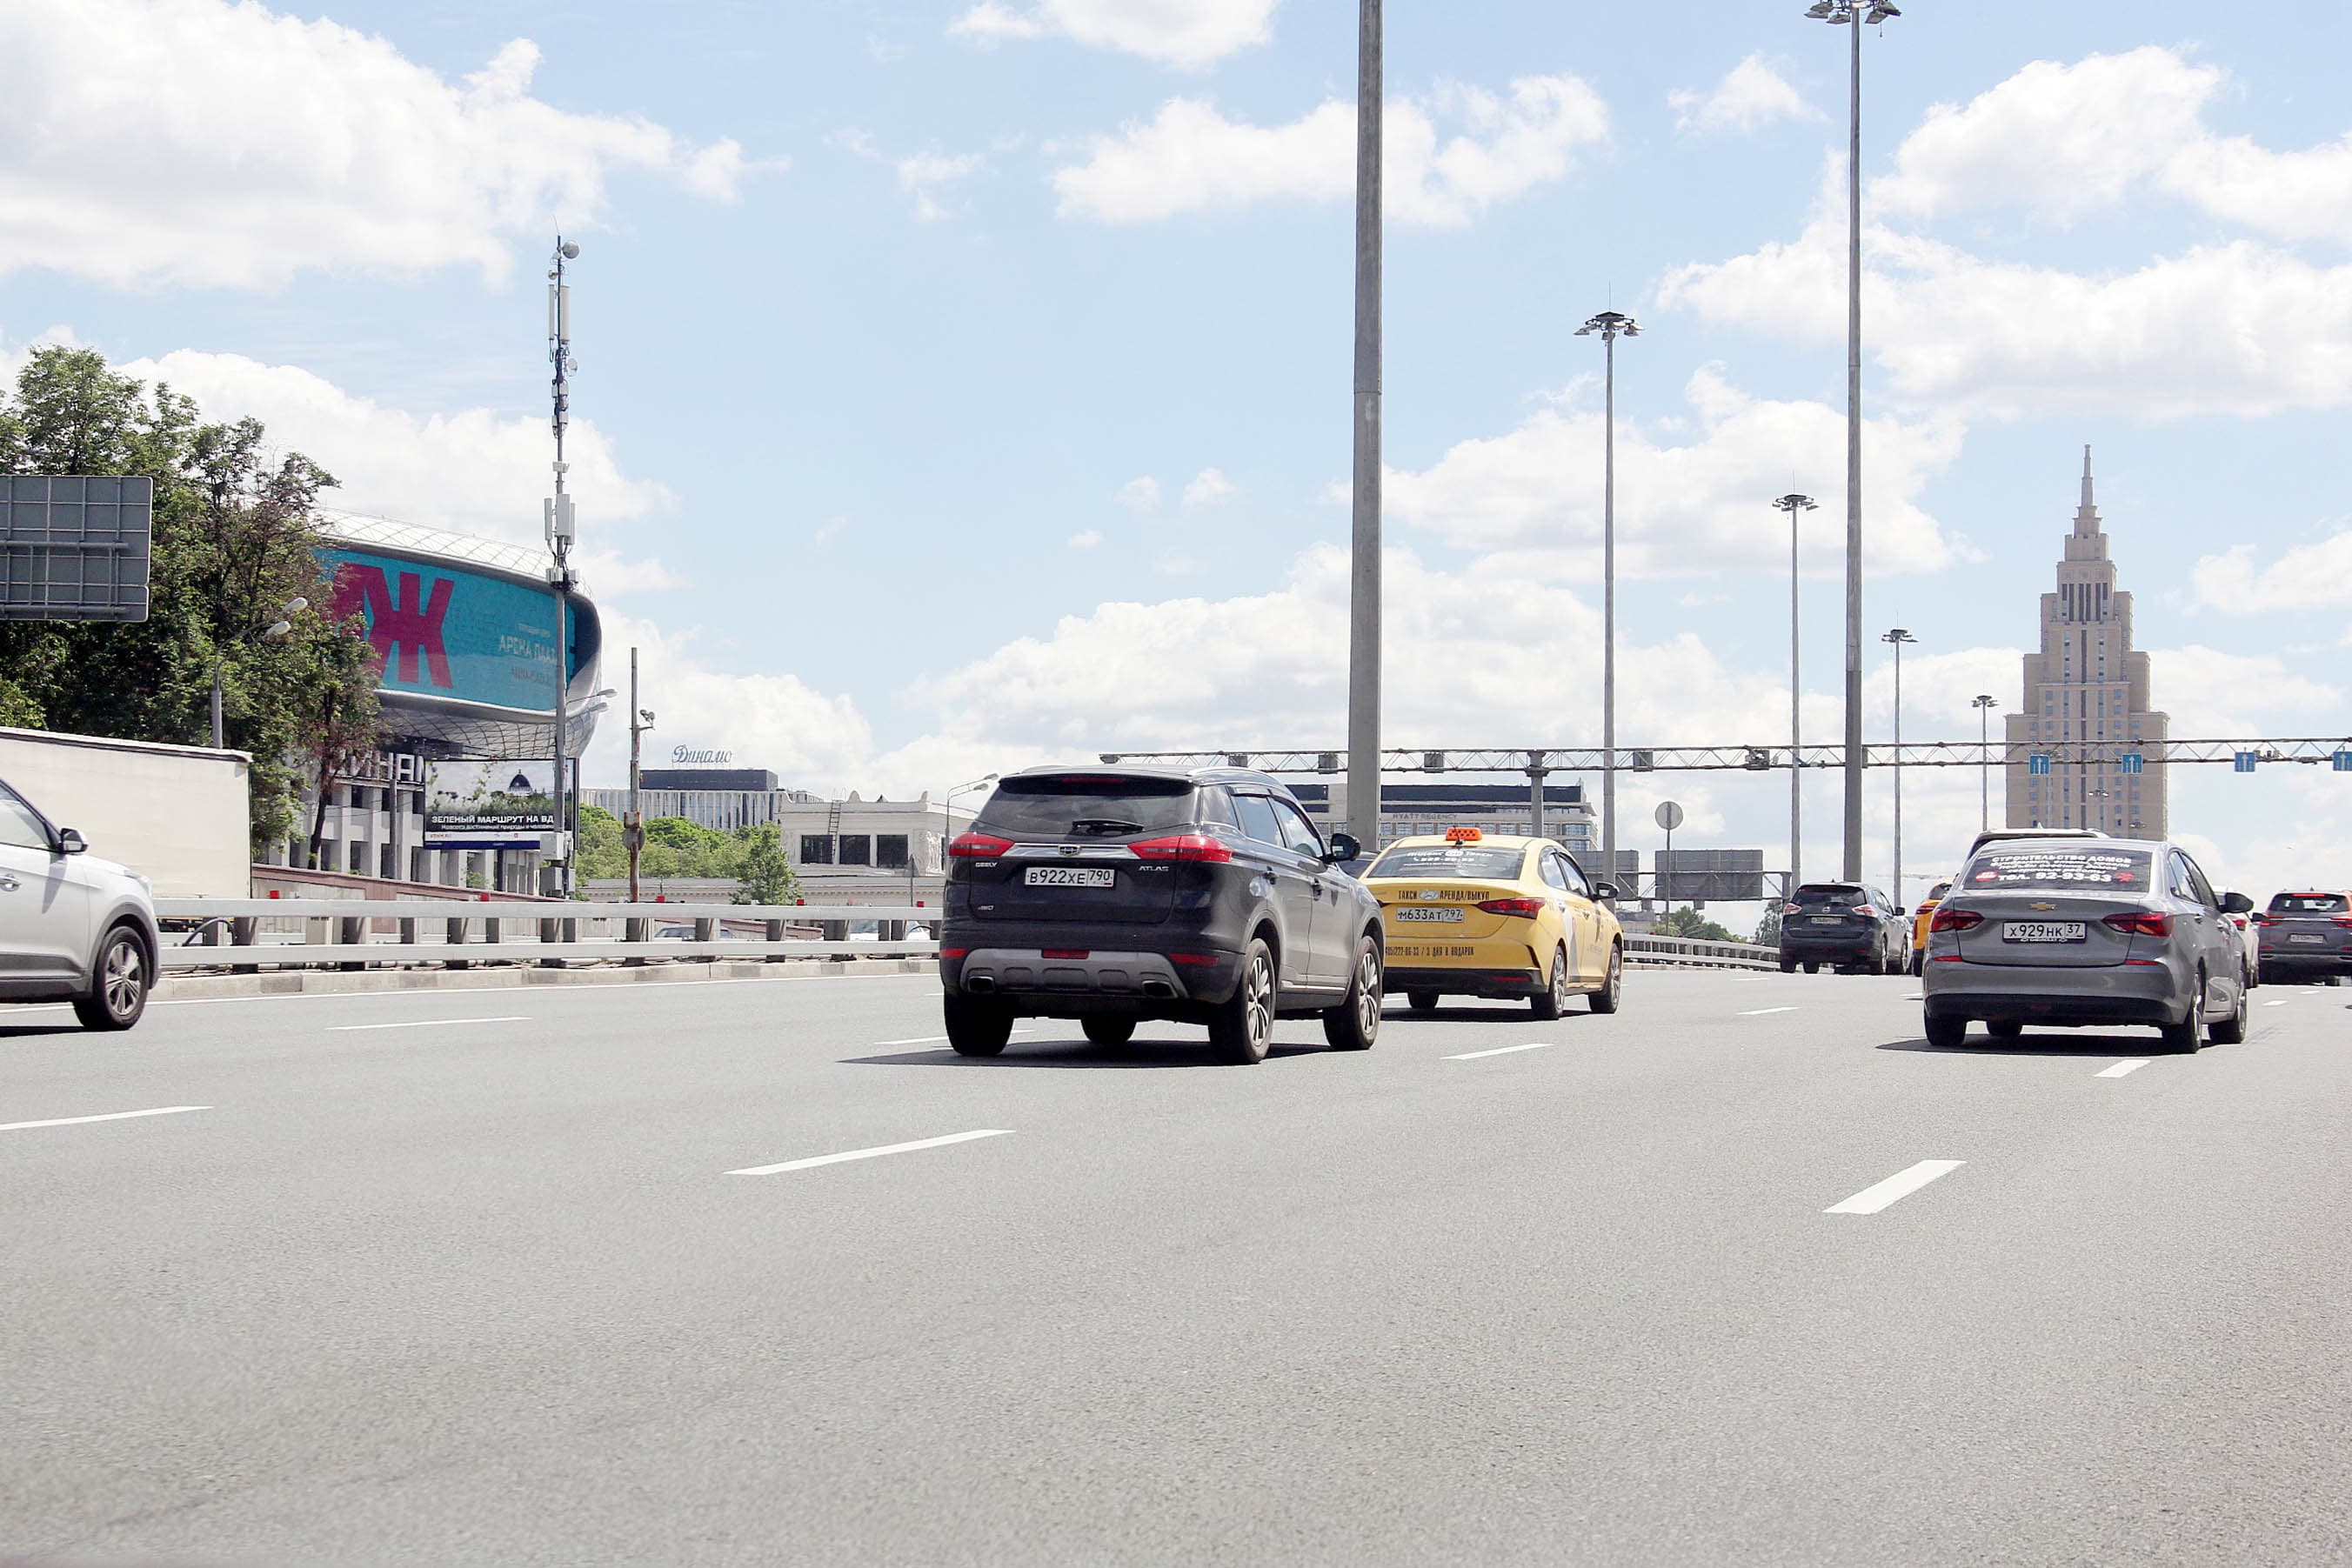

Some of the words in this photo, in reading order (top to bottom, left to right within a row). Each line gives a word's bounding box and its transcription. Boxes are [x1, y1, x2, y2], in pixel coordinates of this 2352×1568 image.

[672, 744, 732, 763] Динамо
[1399, 891, 1418, 900] ТАКСИ
[1440, 891, 1490, 901] АРЕНДА/ВЫКУП
